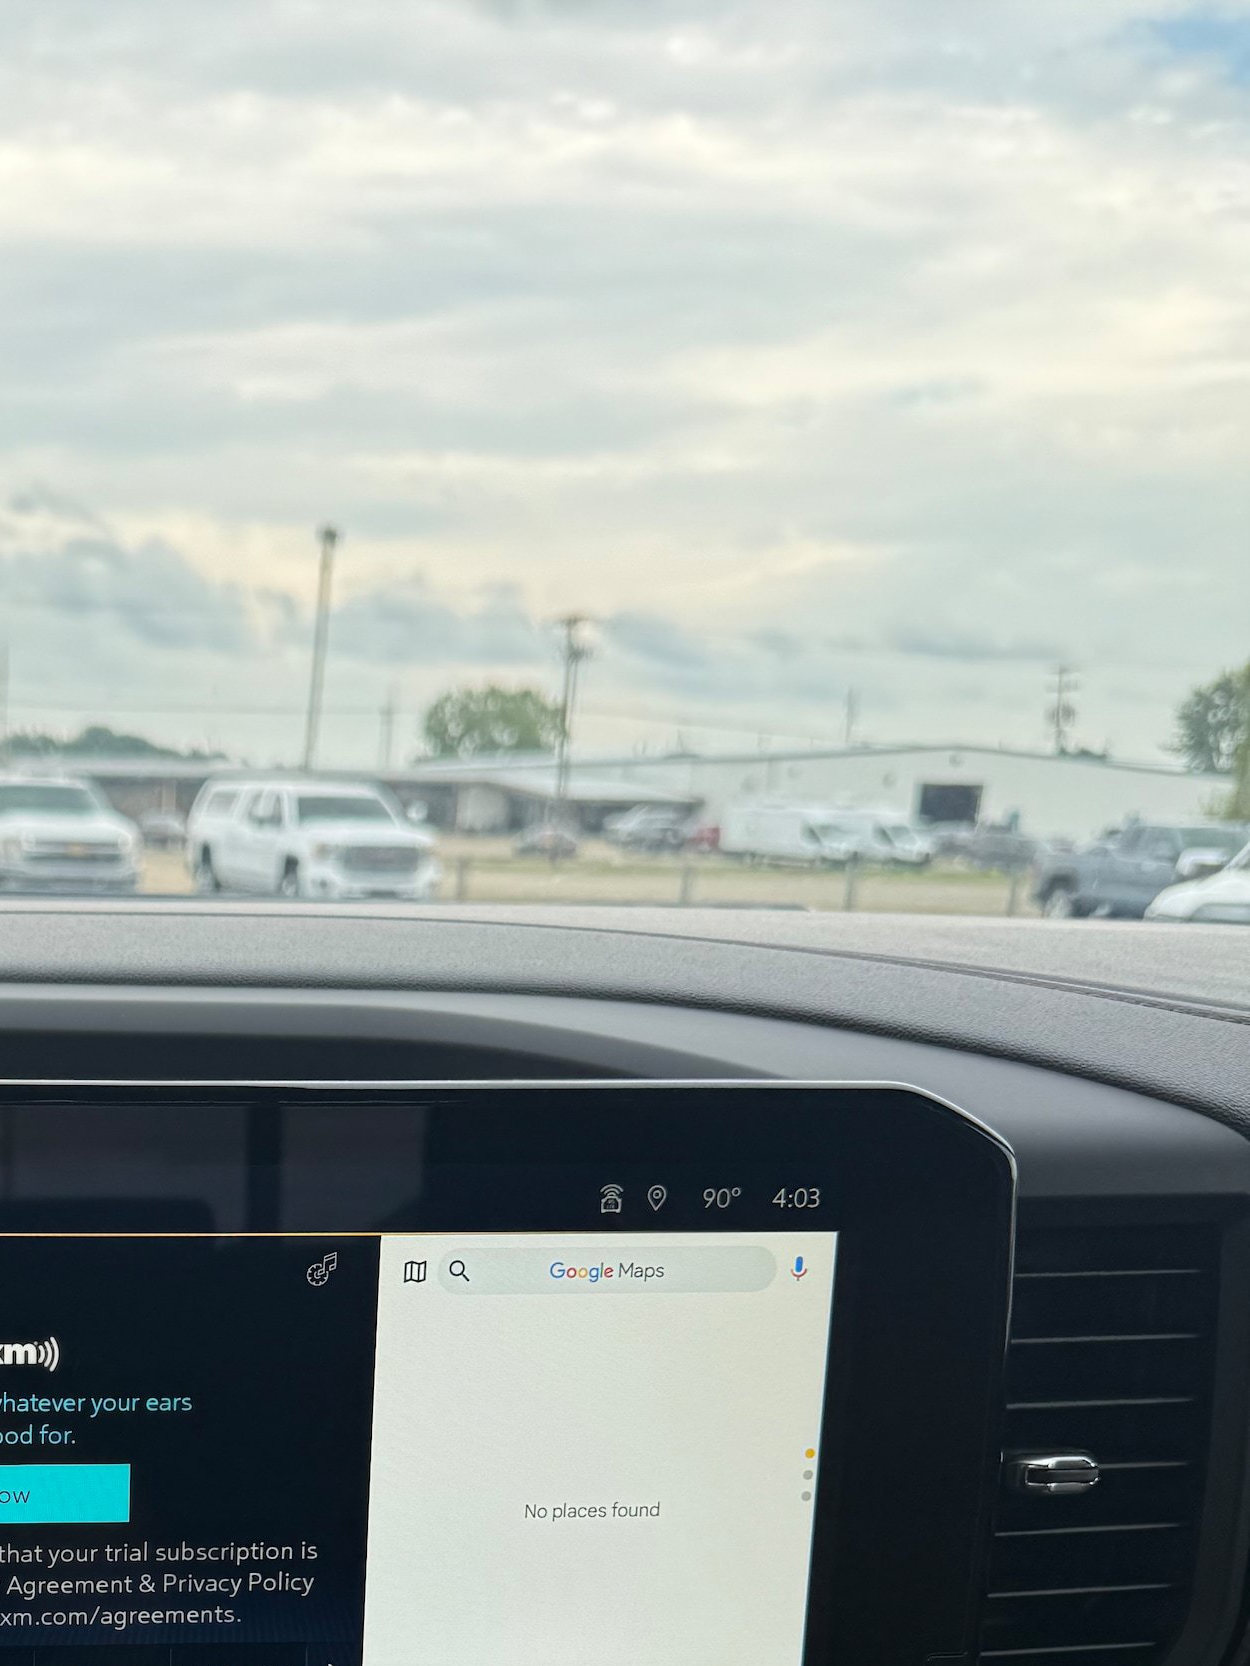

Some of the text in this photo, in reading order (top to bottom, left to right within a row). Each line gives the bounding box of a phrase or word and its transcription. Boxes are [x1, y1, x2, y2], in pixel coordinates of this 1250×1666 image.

[704, 1187, 742, 1209] 90°
[772, 1187, 821, 1209] 4:03
[550, 1261, 665, 1283] Google Maps
[90, 1397, 141, 1418] your
[146, 1396, 193, 1412] ears
[39, 1424, 77, 1445] for.
[525, 1501, 661, 1522] No places found
[48, 1549, 99, 1569] your
[105, 1542, 148, 1563] trial
[156, 1541, 293, 1568] subscription
[302, 1541, 318, 1560] is
[7, 1574, 133, 1600] Agreement
[139, 1574, 156, 1593] &
[163, 1573, 243, 1598] Privacy
[249, 1570, 315, 1597] Policy
